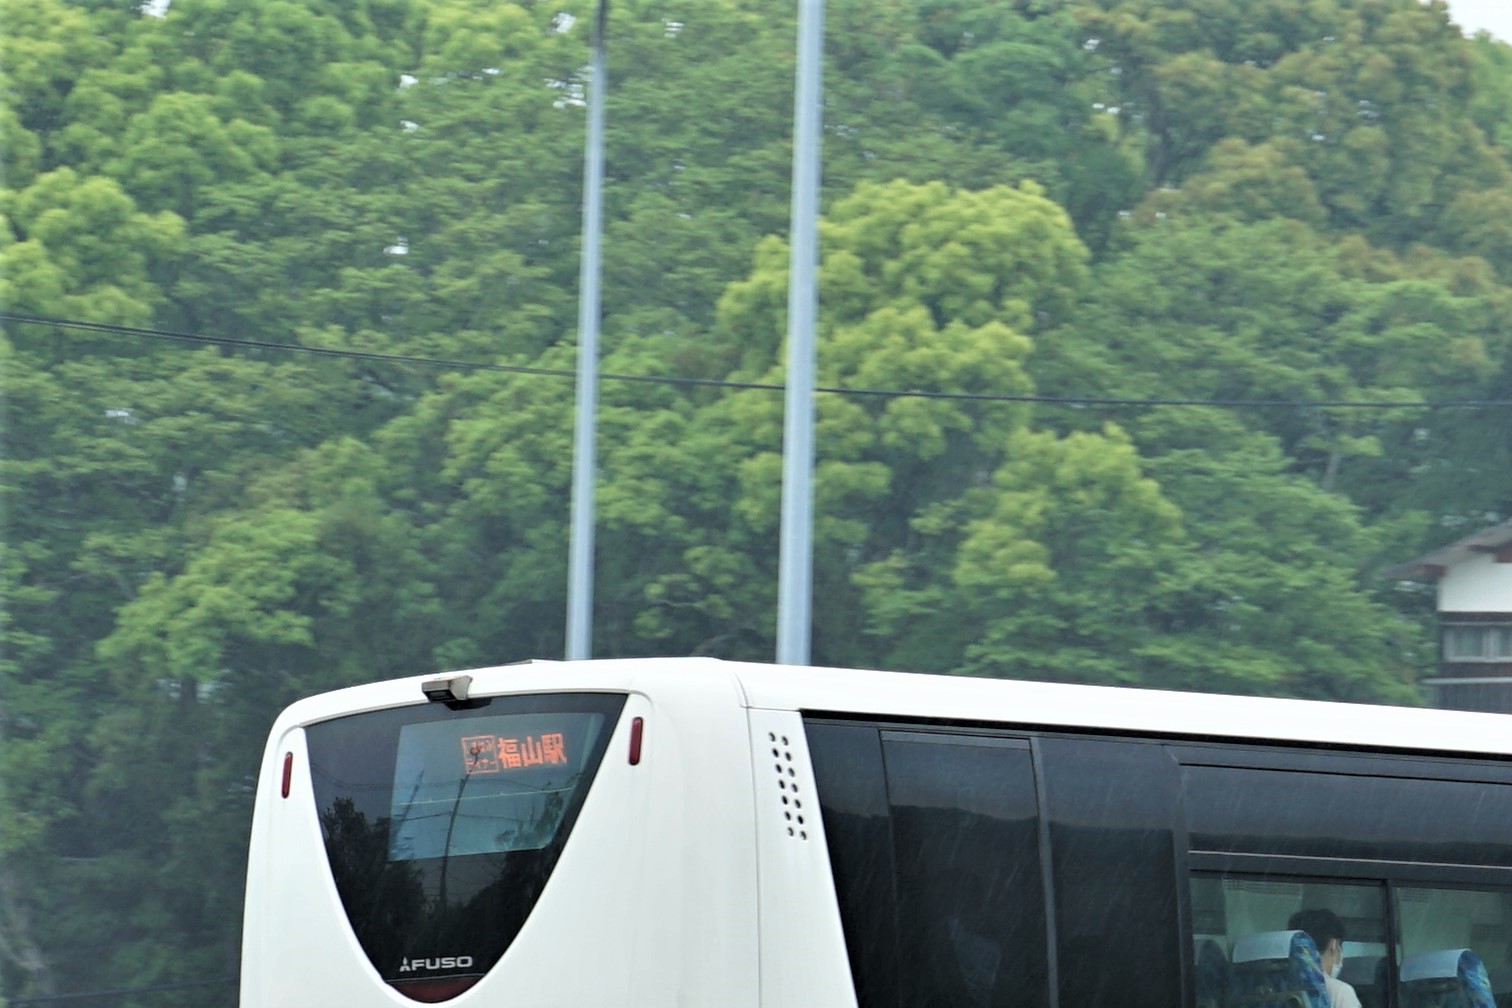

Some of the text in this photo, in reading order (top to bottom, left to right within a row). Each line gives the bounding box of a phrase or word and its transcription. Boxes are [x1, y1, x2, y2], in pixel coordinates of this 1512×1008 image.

[498, 733, 567, 768] 福山駅
[411, 956, 473, 971] FUSO
